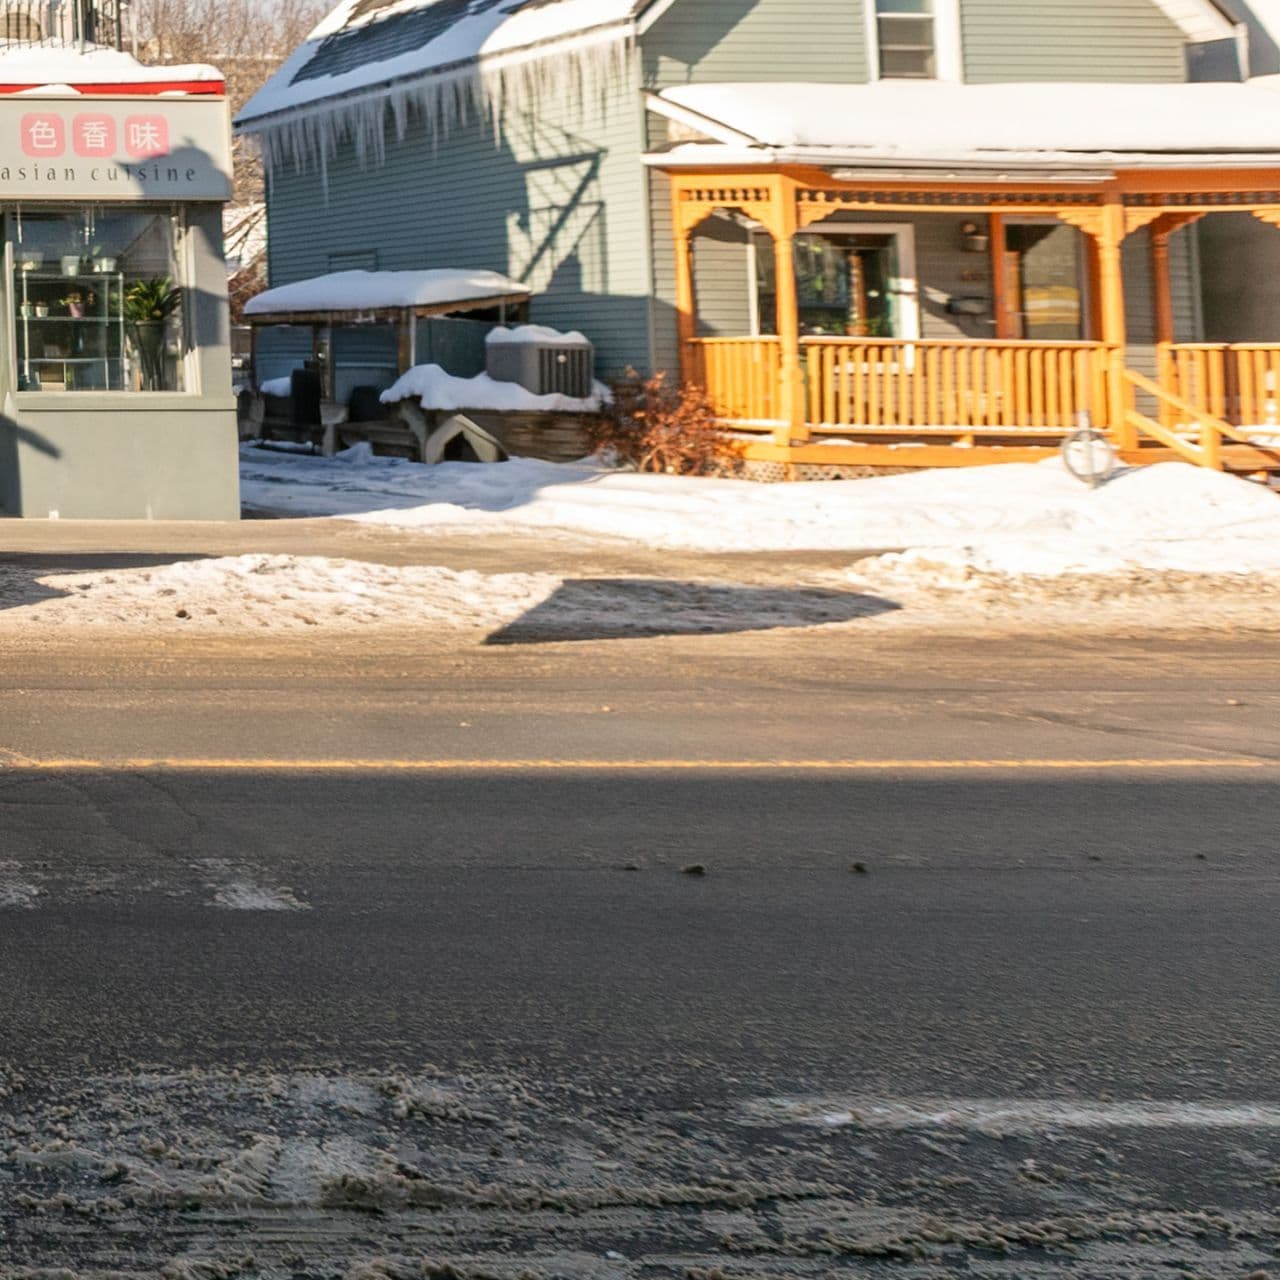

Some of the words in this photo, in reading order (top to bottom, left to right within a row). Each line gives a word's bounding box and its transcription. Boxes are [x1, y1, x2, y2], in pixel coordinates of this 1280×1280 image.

[28, 120, 161, 152] 色香味
[0, 164, 76, 181] asian
[90, 164, 196, 182] cuisine
